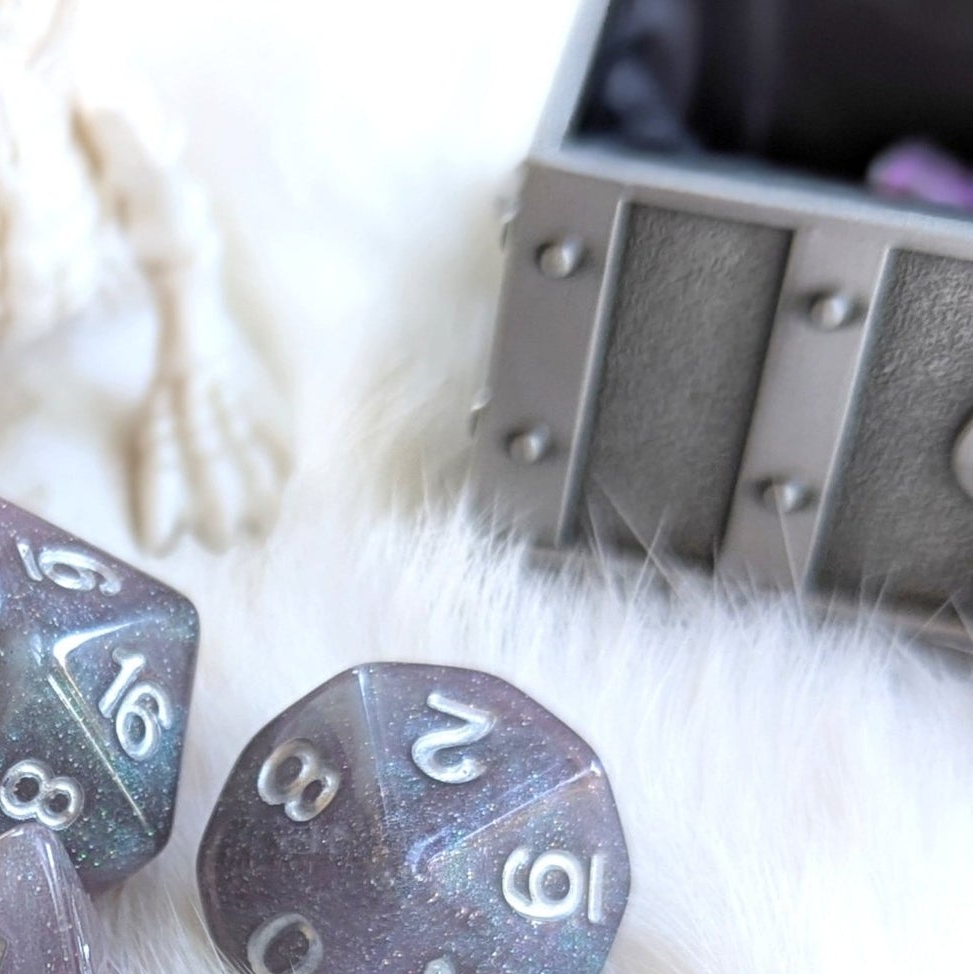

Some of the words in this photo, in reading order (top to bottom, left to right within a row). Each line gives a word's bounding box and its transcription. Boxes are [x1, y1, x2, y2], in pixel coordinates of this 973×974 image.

[98, 646, 173, 761] 16
[411, 692, 498, 785] 2
[257, 737, 341, 823] 8
